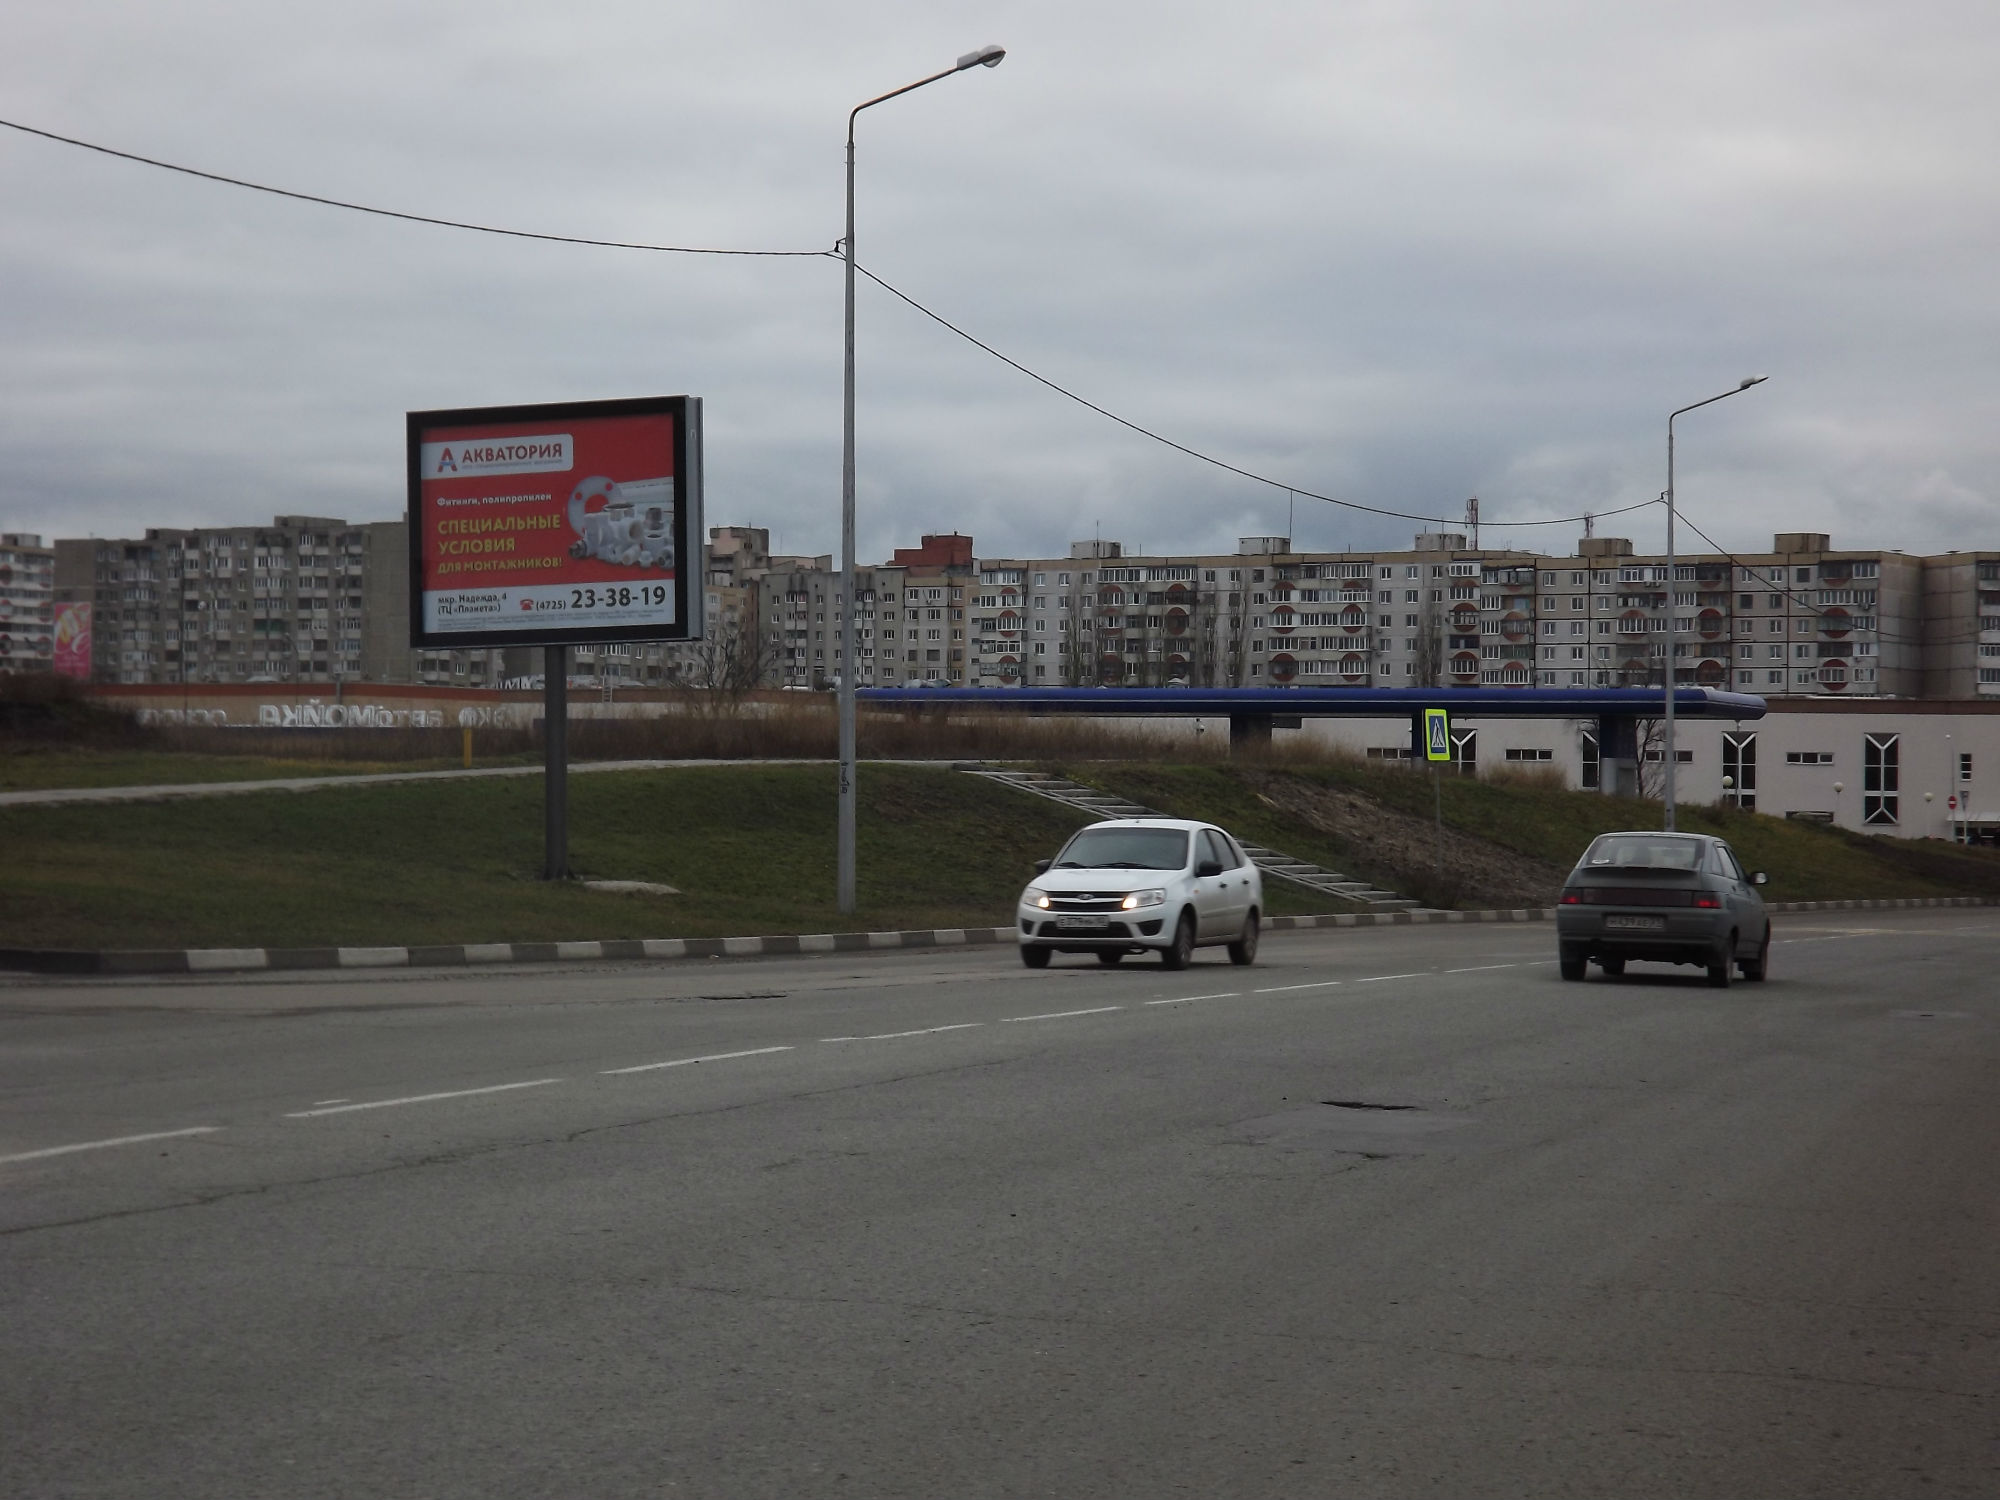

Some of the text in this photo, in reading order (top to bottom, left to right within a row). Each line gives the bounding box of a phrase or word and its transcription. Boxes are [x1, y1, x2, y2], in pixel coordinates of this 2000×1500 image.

[462, 443, 562, 463] АКВАТОРИЯ
[436, 494, 552, 507] Фитинги, полипропилен
[437, 514, 561, 535] СПЕЦИАЛЬНЫЕ
[438, 537, 515, 555] УСЛОВИЯ
[437, 557, 562, 574] ДЛЯ МОНТАЖНИКОВ!
[536, 586, 666, 611] (4725) 23-38-19
[438, 605, 452, 615] (ТЦ
